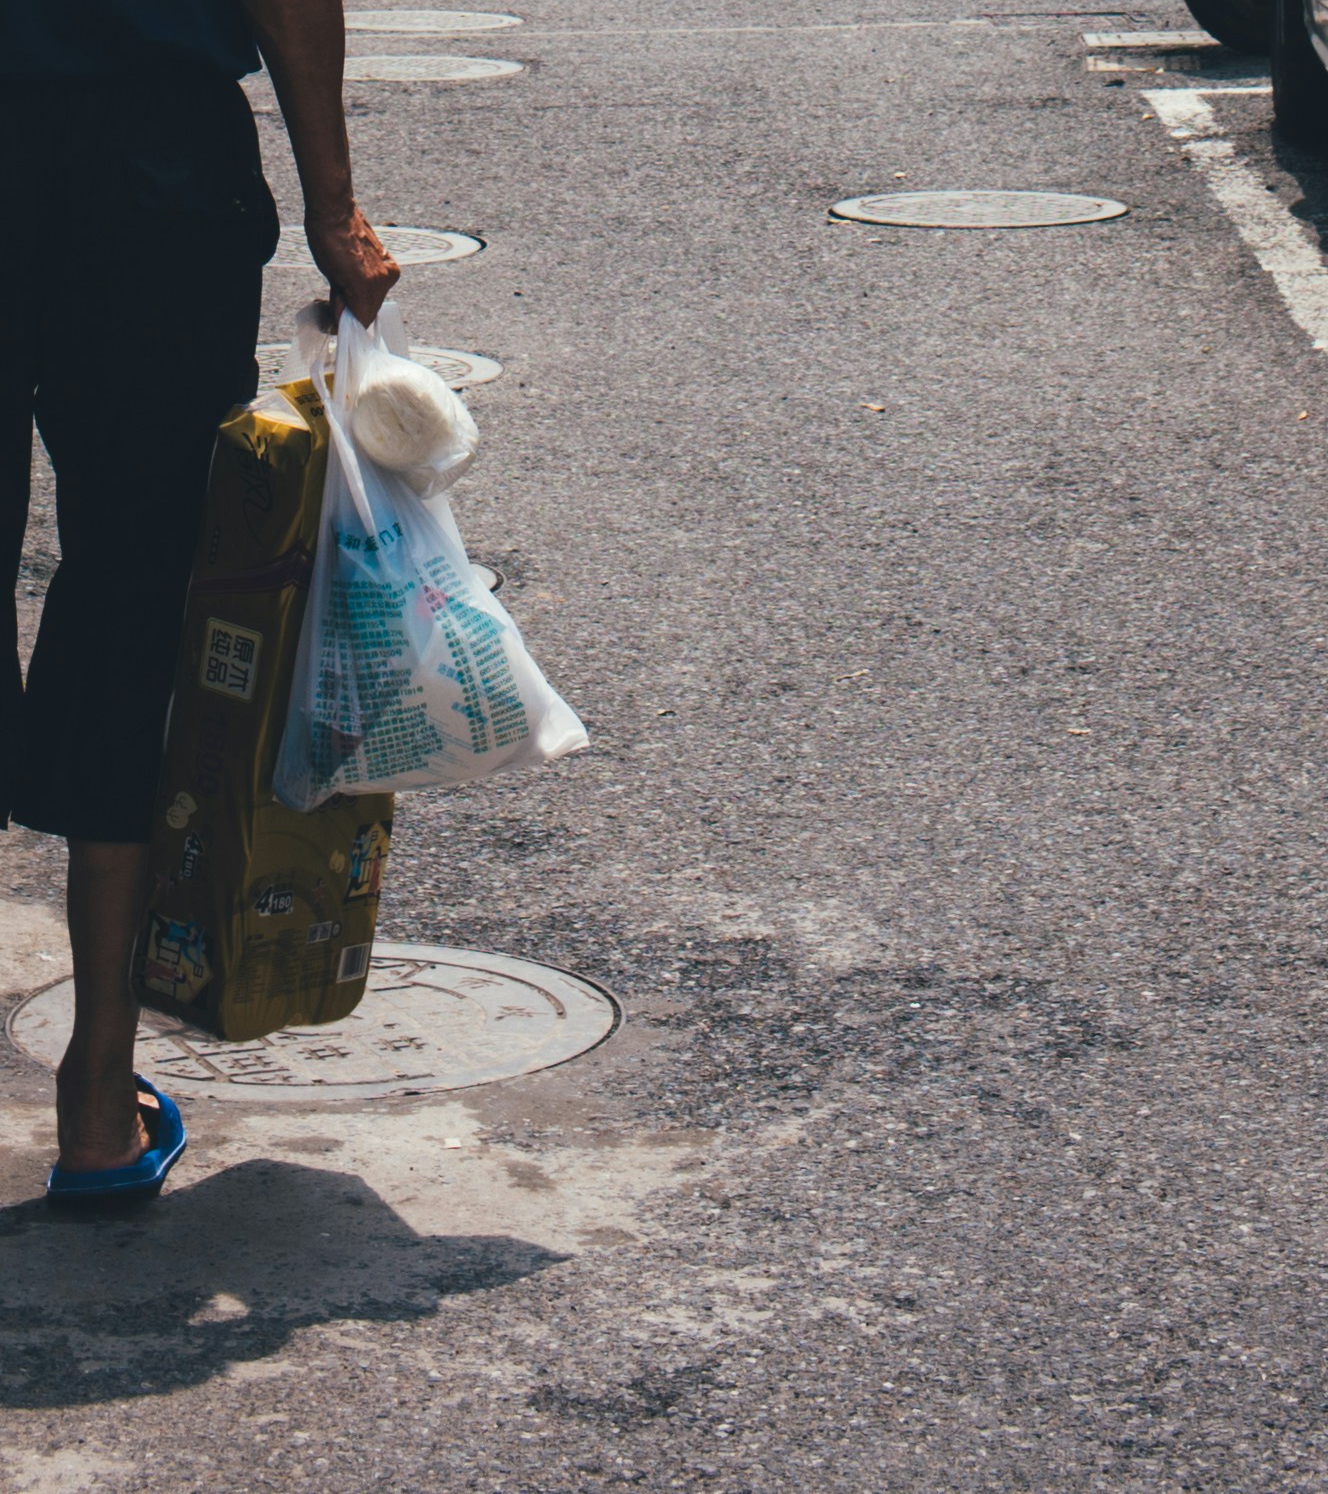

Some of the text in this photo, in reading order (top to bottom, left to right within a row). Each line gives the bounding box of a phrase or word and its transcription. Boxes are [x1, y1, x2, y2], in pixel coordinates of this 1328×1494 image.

[206, 628, 233, 684] 纯品
[228, 634, 256, 693] 原木
[273, 895, 292, 911] 180
